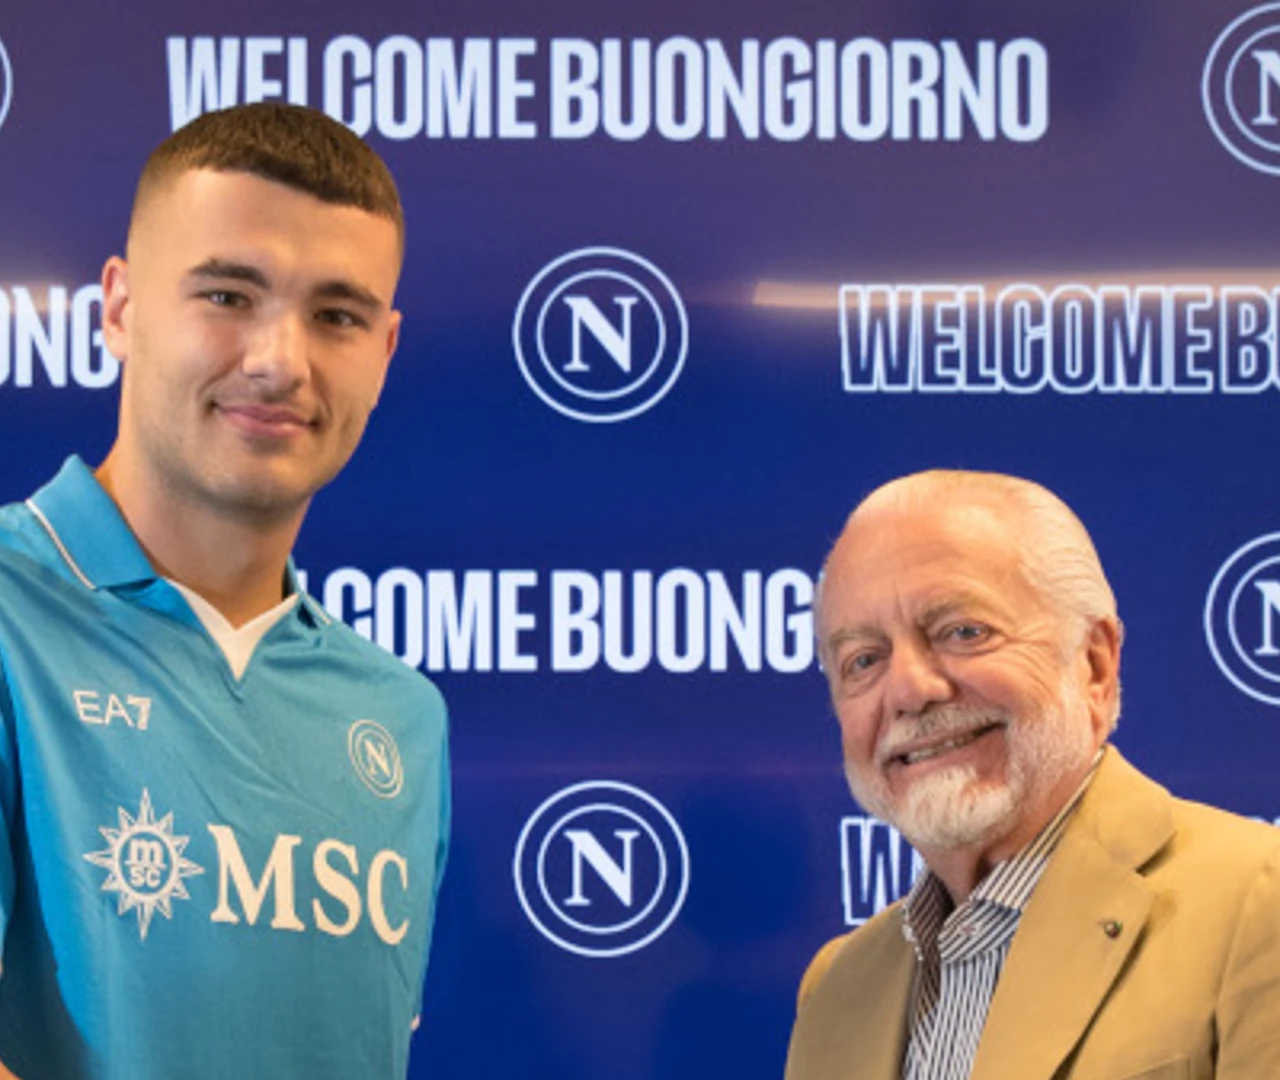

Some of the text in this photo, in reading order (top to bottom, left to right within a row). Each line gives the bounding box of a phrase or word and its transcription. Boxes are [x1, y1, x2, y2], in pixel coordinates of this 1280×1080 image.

[550, 37, 1048, 142] BUONGIORNO
[562, 294, 640, 374] N
[840, 284, 1214, 393] WELCOME
[296, 567, 825, 673] COME BUONG
[73, 689, 152, 730] EA7
[207, 822, 410, 946] MSC
[563, 829, 640, 907] N
